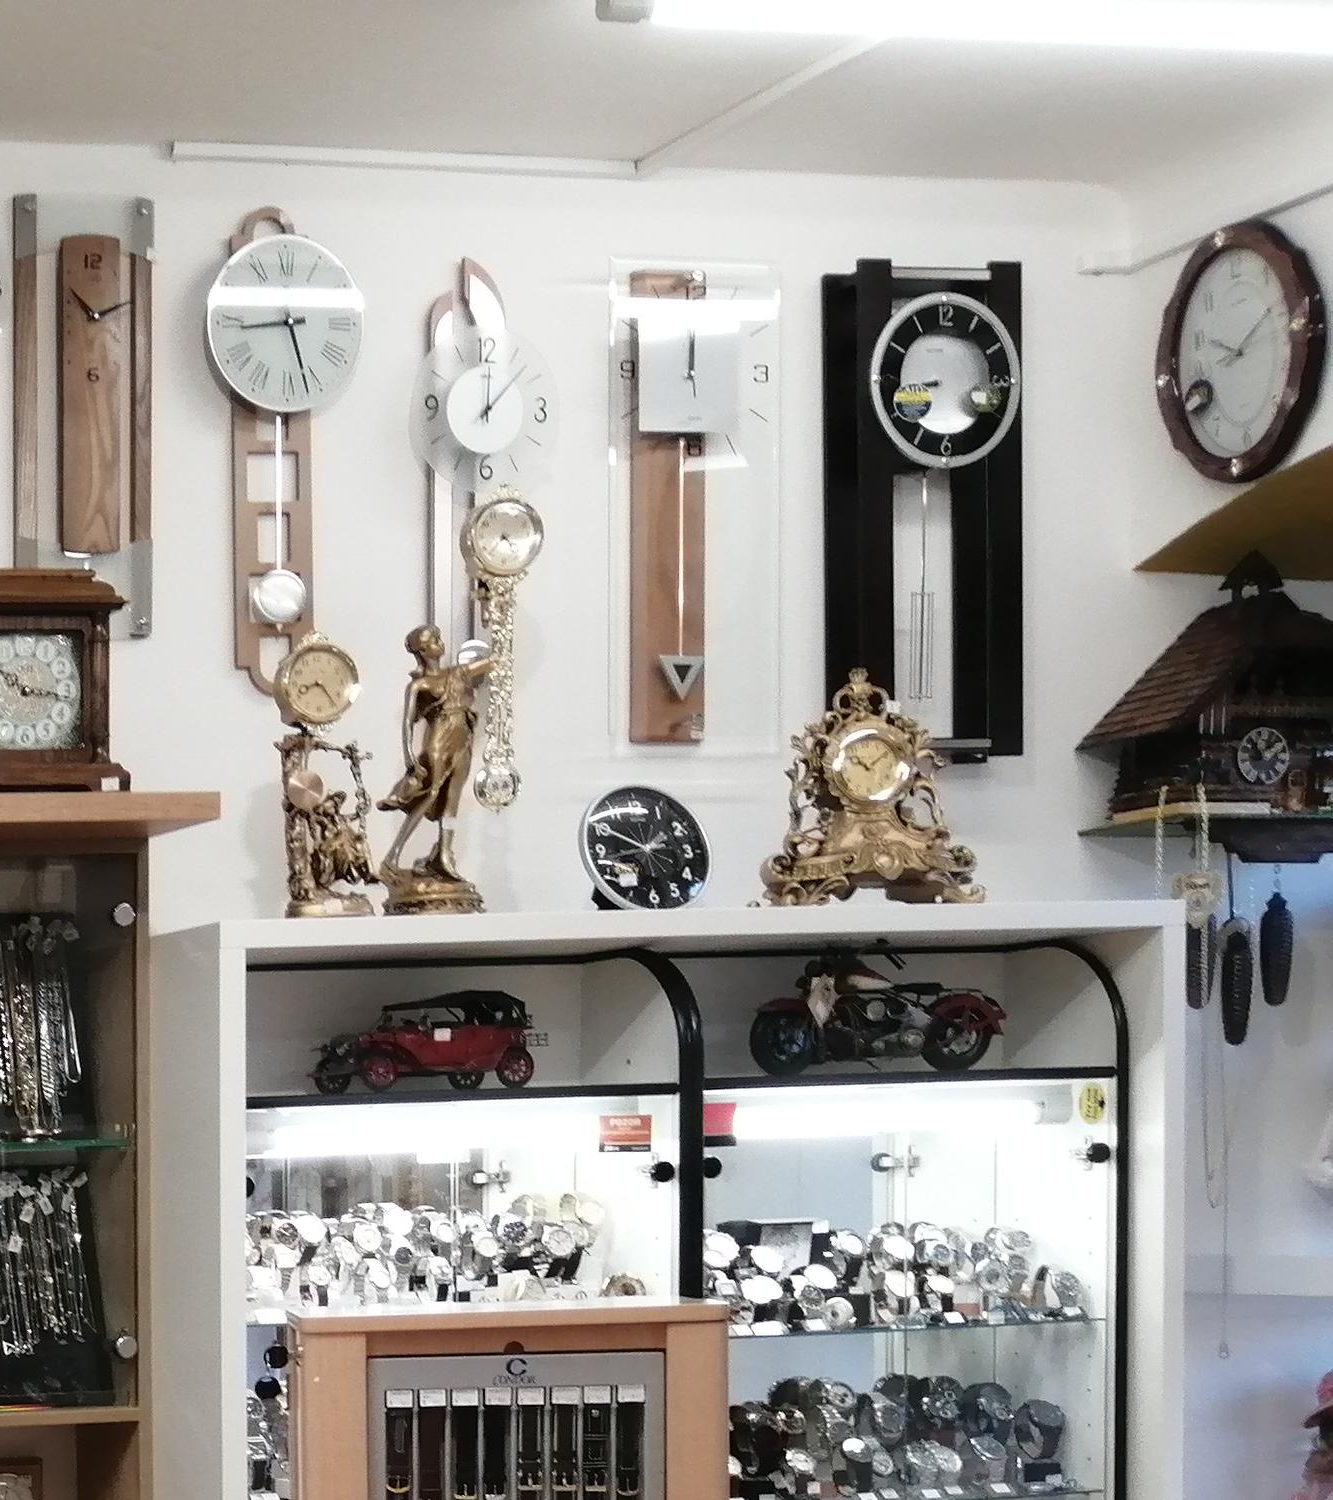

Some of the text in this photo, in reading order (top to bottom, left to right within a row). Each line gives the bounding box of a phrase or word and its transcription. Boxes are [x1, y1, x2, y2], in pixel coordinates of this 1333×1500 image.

[84, 253, 102, 269] 12
[939, 305, 953, 326] 12
[478, 337, 497, 363] 12
[87, 368, 99, 382] 6
[621, 360, 635, 379] 9
[753, 365, 768, 382] 3
[425, 394, 439, 420] 9
[534, 397, 547, 423] 3
[941, 435, 952, 456] 6
[480, 454, 493, 480] 6
[655, 806, 661, 820] 1
[594, 822, 610, 836] 10
[671, 821, 683, 836] 2
[595, 843, 606, 858] 9
[682, 844, 693, 858] 3
[682, 867, 692, 880] 4
[649, 889, 660, 904] 6
[669, 882, 680, 897] 5
[506, 1358, 527, 1375] C
